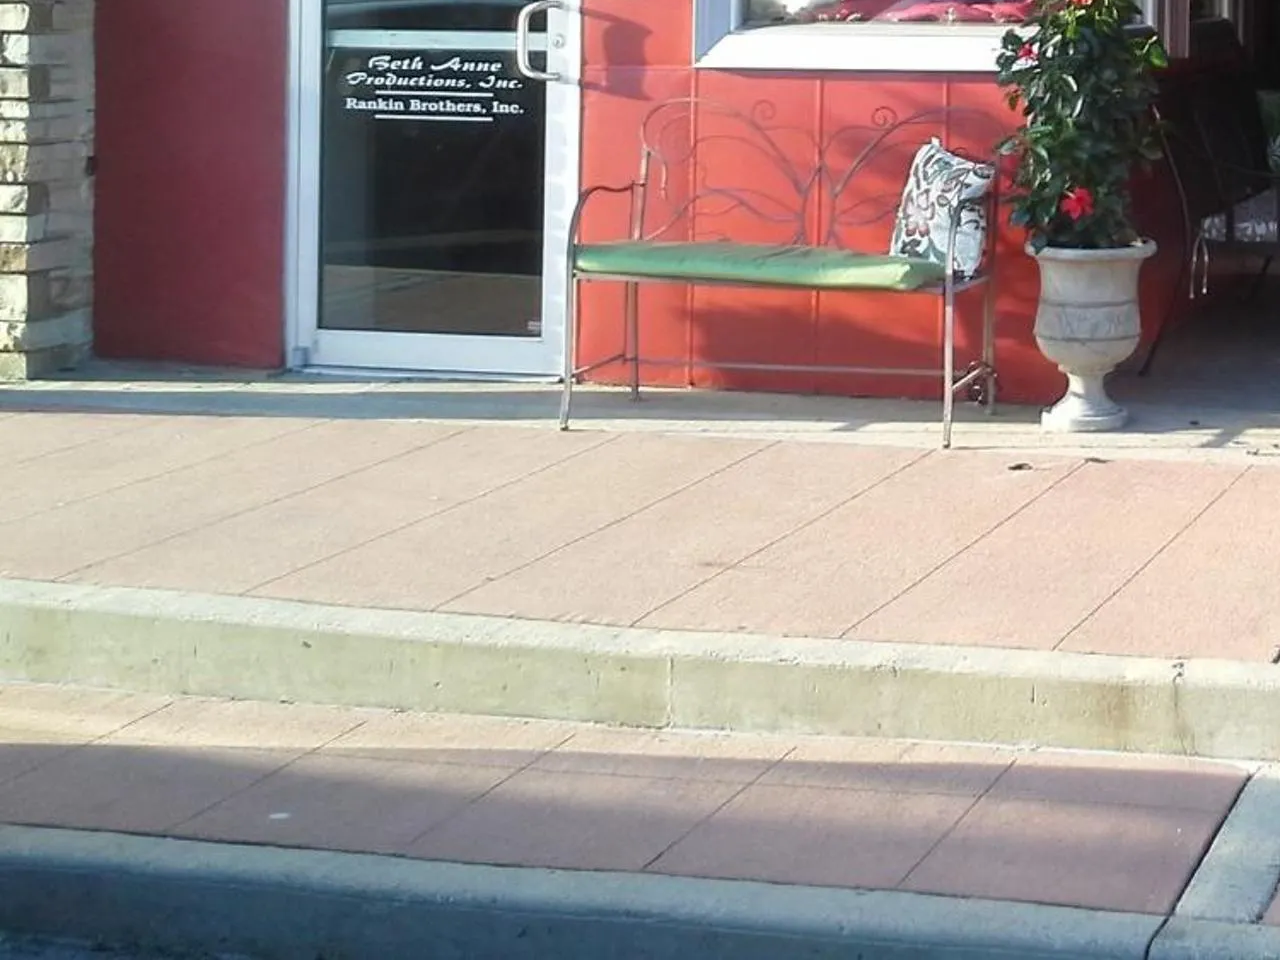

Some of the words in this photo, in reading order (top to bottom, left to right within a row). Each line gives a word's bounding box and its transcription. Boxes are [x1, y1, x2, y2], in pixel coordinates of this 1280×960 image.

[368, 55, 424, 71] Beth
[430, 57, 502, 72] Anne
[346, 72, 472, 88] Productions,
[478, 75, 523, 89] Inc.
[345, 98, 404, 111] Rankin
[409, 99, 487, 114] Brothers,
[492, 101, 524, 114] Inc.
